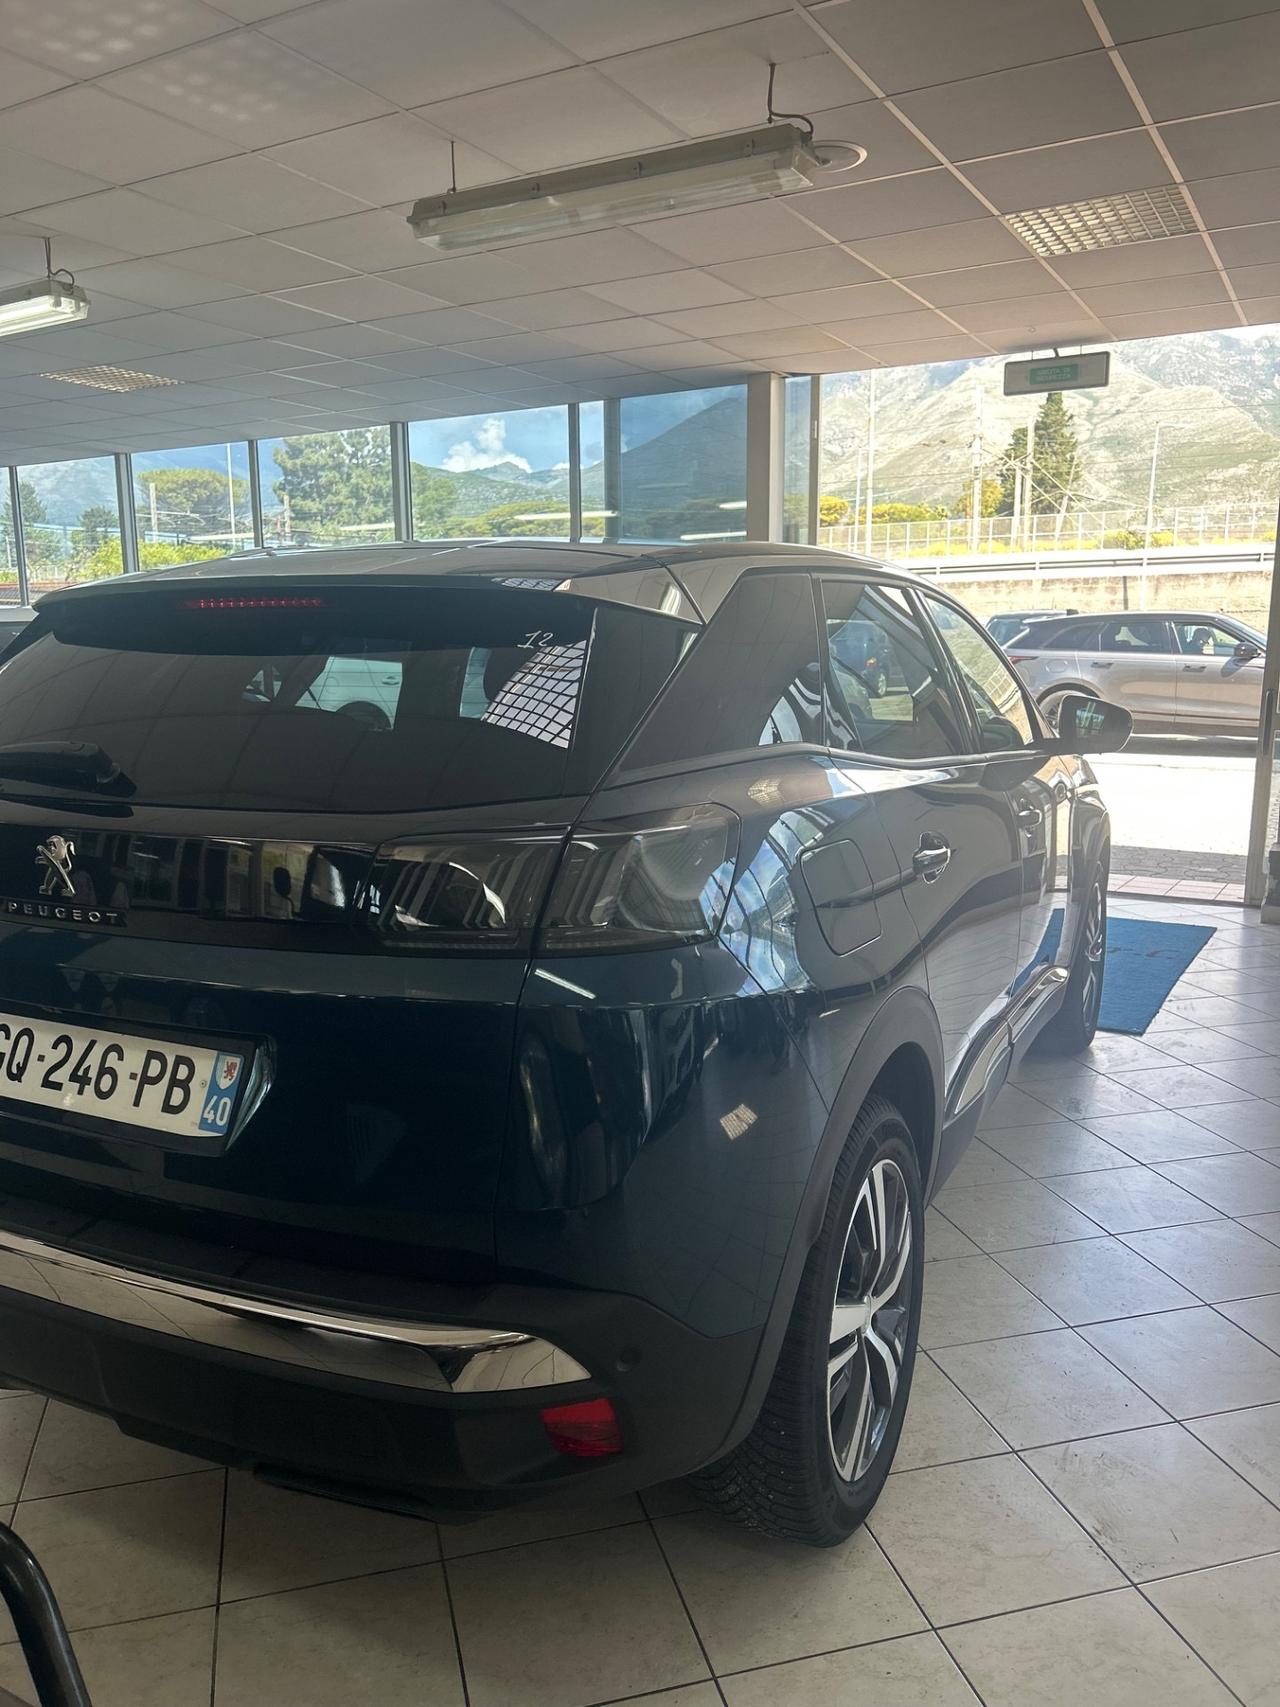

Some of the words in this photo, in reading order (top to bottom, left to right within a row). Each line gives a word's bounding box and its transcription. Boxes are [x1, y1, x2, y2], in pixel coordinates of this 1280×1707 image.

[517, 630, 554, 648] 12
[8, 901, 118, 924] PEUGEOT
[203, 1095, 231, 1126] 40
